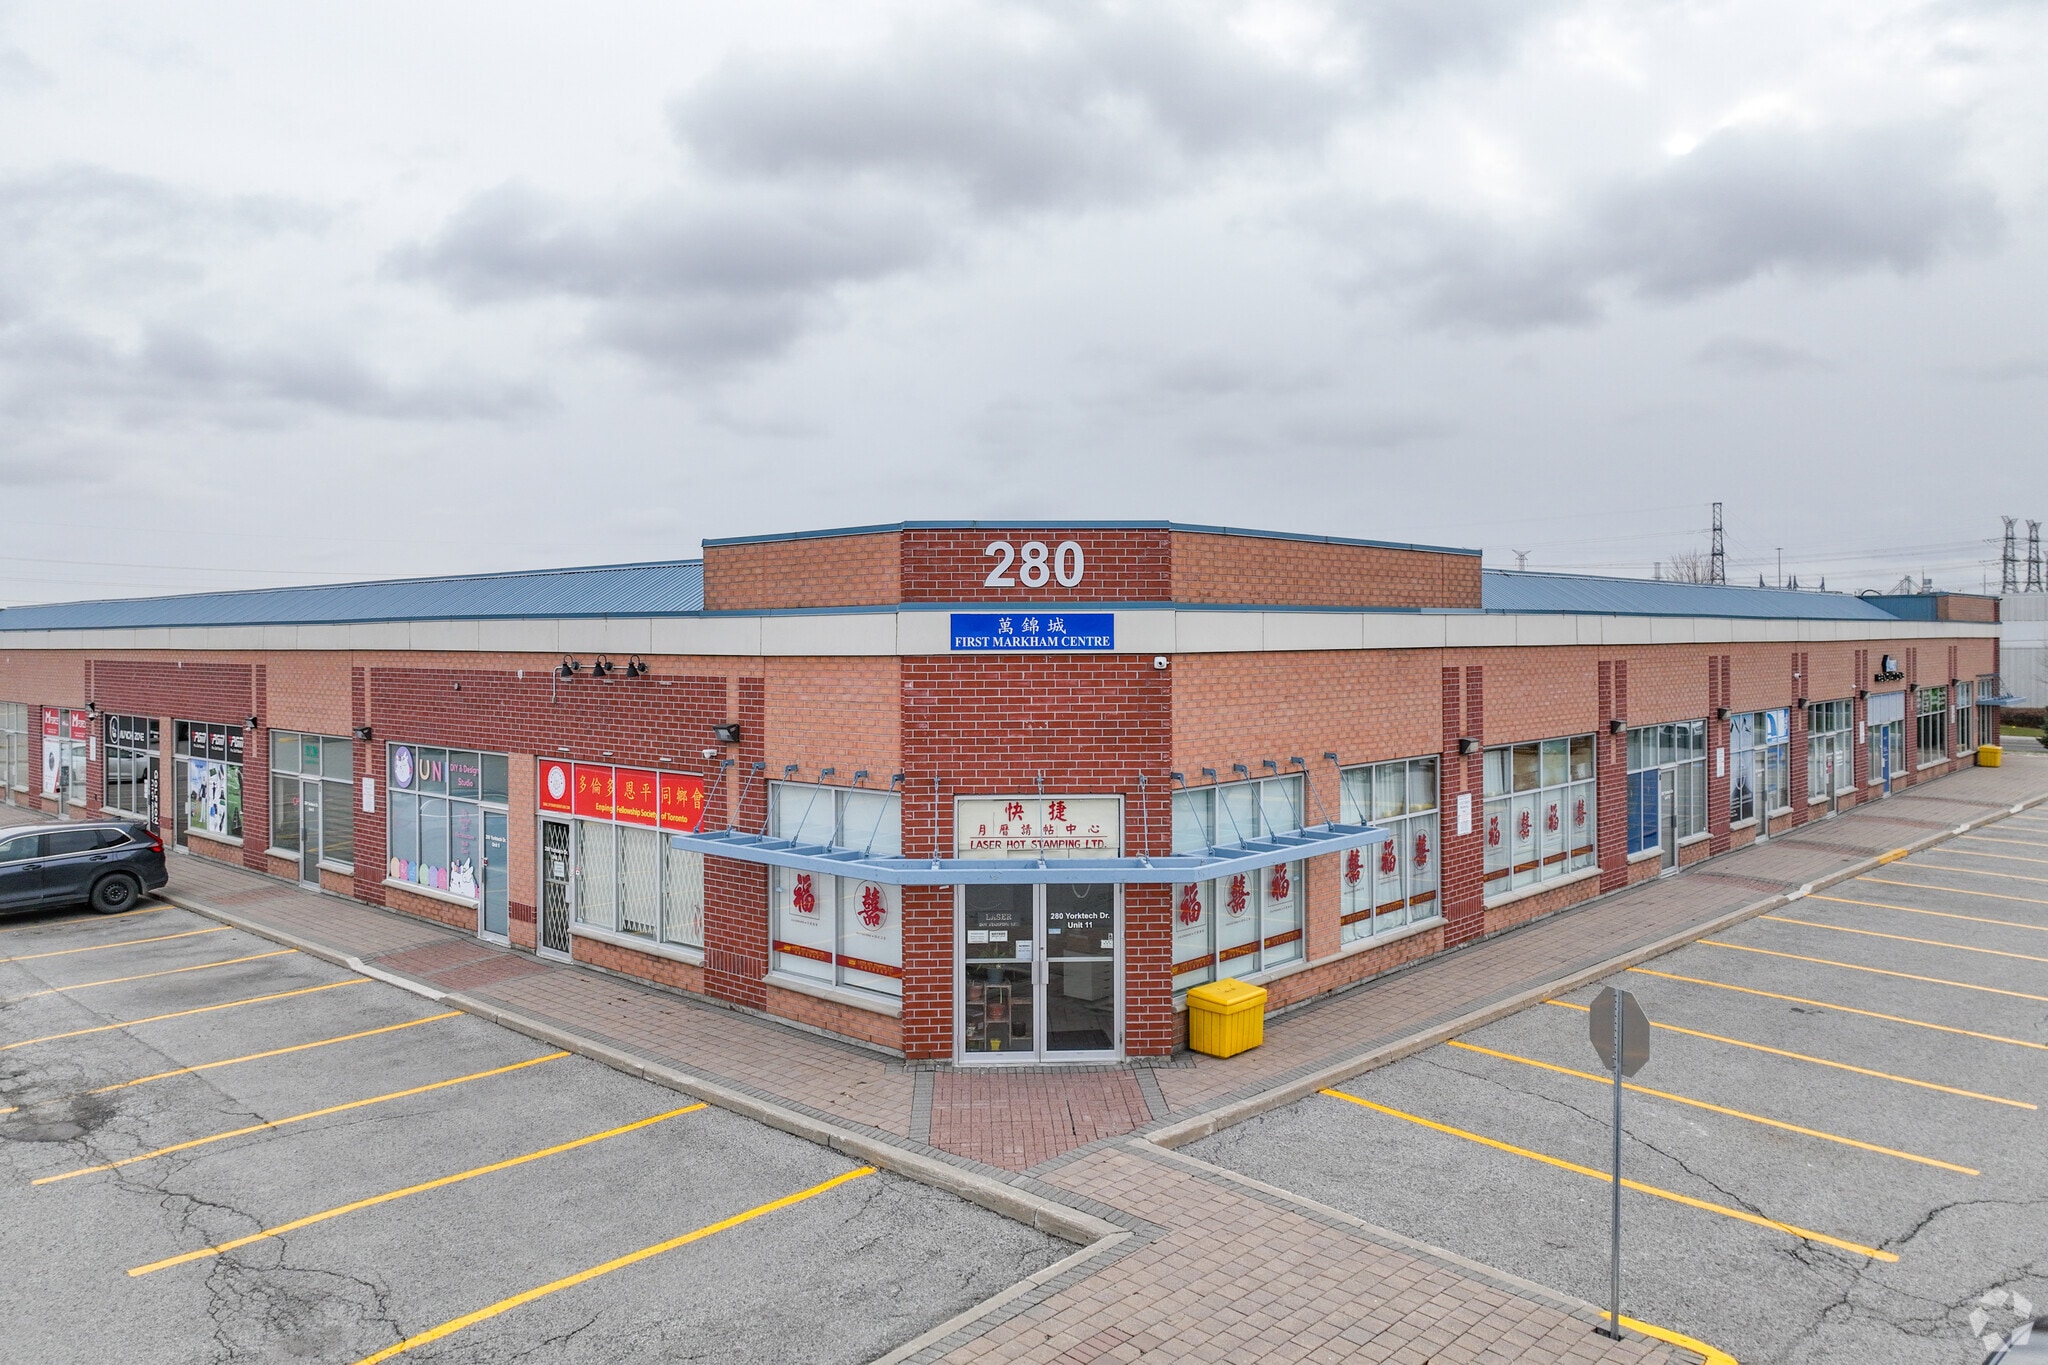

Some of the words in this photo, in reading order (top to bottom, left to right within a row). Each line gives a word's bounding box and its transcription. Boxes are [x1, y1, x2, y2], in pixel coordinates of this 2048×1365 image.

[984, 540, 1084, 588] 280
[998, 616, 1066, 634] 萬錦城
[955, 637, 989, 647] FIRST
[993, 637, 1058, 647] MARKHAM
[1062, 636, 1110, 646] CENTRE
[459, 764, 463, 772] &
[463, 764, 479, 776] Design
[457, 778, 473, 787] Studio
[596, 802, 613, 814] Enping
[616, 805, 640, 817] Fellowship
[641, 809, 657, 820] Society
[667, 813, 688, 823] Toronto
[1005, 801, 1067, 821] 快捷
[970, 840, 1001, 849] LASER
[1007, 840, 1026, 849] HOT
[1031, 840, 1081, 849] STAMPING
[1085, 840, 1107, 848] LTD.
